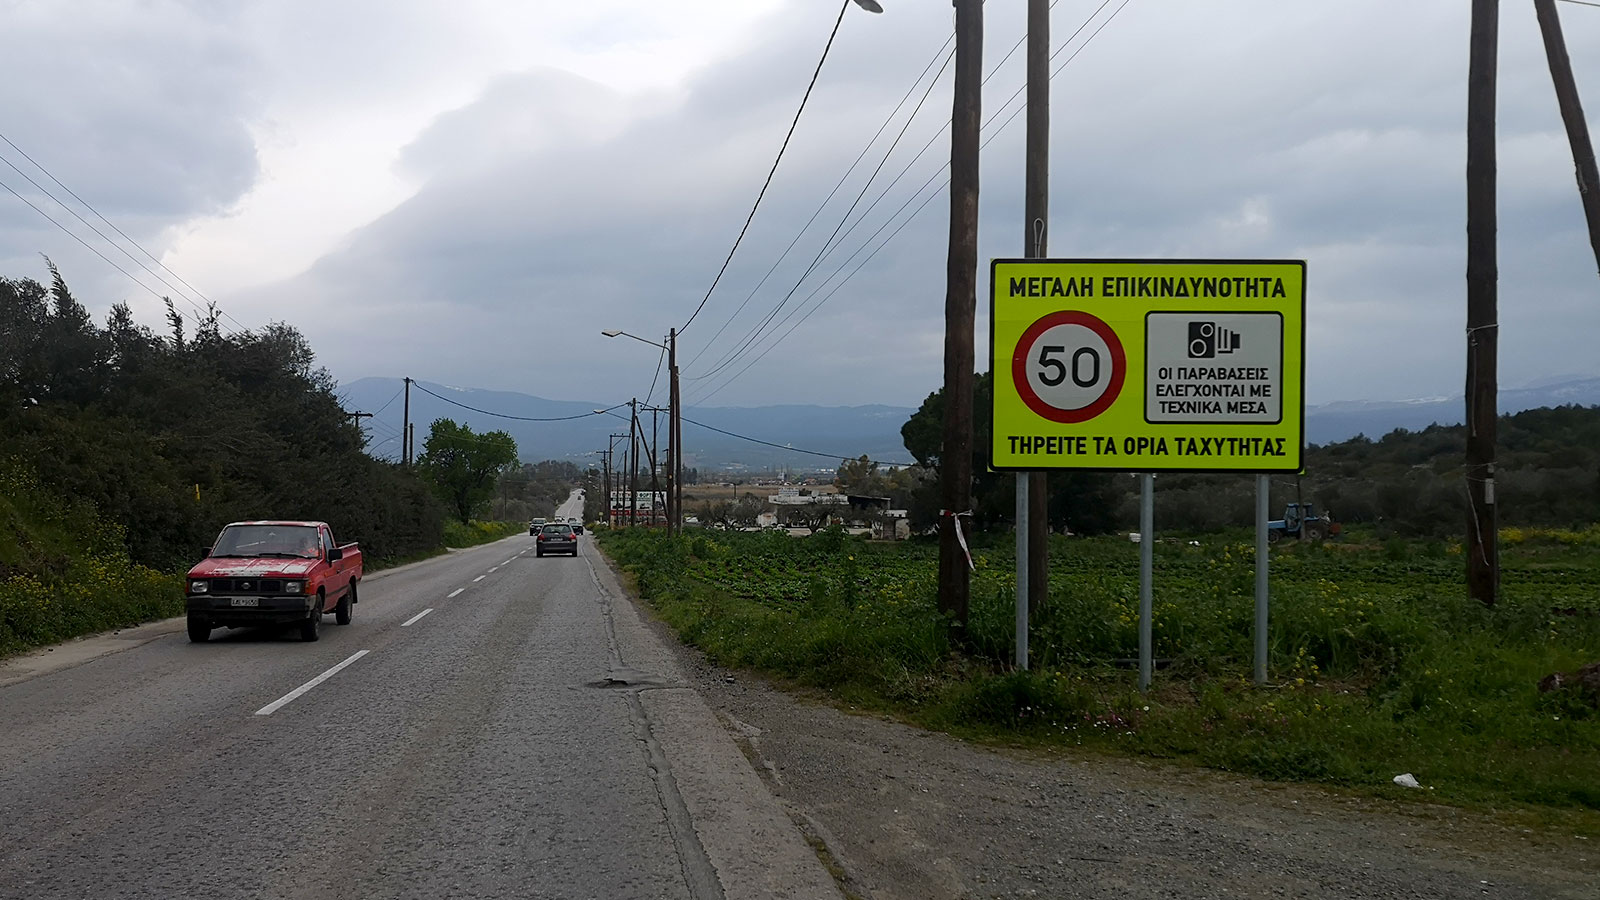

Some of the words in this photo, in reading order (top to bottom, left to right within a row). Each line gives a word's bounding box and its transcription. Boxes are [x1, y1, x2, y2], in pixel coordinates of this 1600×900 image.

[1010, 277, 1093, 297] ΜΕΓΑΛΗ
[1103, 277, 1286, 297] ΕΠΙΚΙΝΔΥΝΟΤΗΤΑ
[1038, 346, 1100, 387] 50
[1159, 367, 1172, 379] ΟΙ
[1178, 368, 1268, 380] ΠΑΡΑΒΑΣΕΙΣ
[1156, 384, 1244, 397] ΕΛΕΓΧΟΝΤΑΙ
[1250, 385, 1271, 397] ΜΕ
[1159, 401, 1222, 413] ΤΕΧΝΙΚΑ
[1227, 402, 1267, 413] ΜΕΣΑ
[1008, 436, 1087, 454] ΤΗΡΕΙΤΕ
[1093, 437, 1117, 455] ΤΑ
[1124, 437, 1168, 455] ΟΡΙΑ
[1174, 438, 1286, 456] ΤΑΧΥΤΗΤΑΣ
